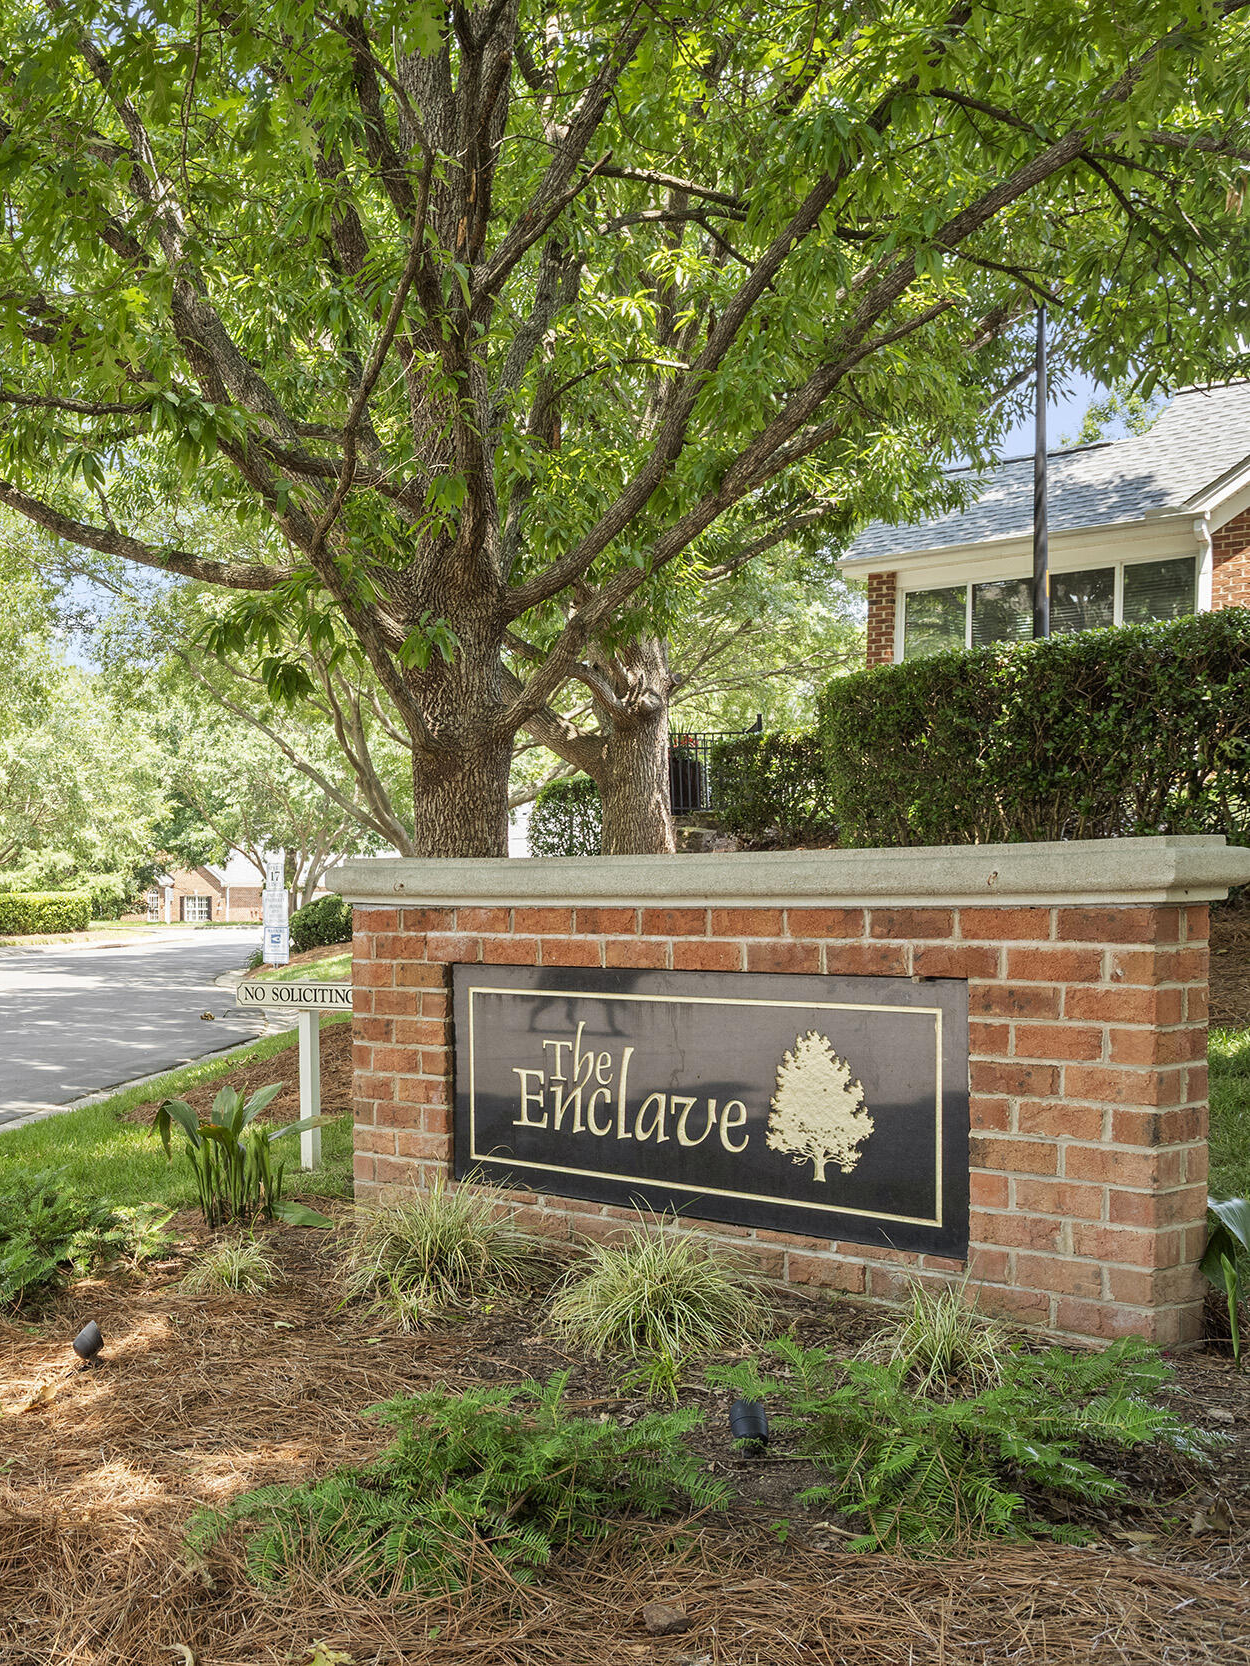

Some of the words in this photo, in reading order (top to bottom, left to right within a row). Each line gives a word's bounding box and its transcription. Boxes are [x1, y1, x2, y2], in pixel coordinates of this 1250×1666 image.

[244, 986, 266, 1001] NO
[542, 1020, 614, 1086] The
[511, 1046, 750, 1153] Enclave
